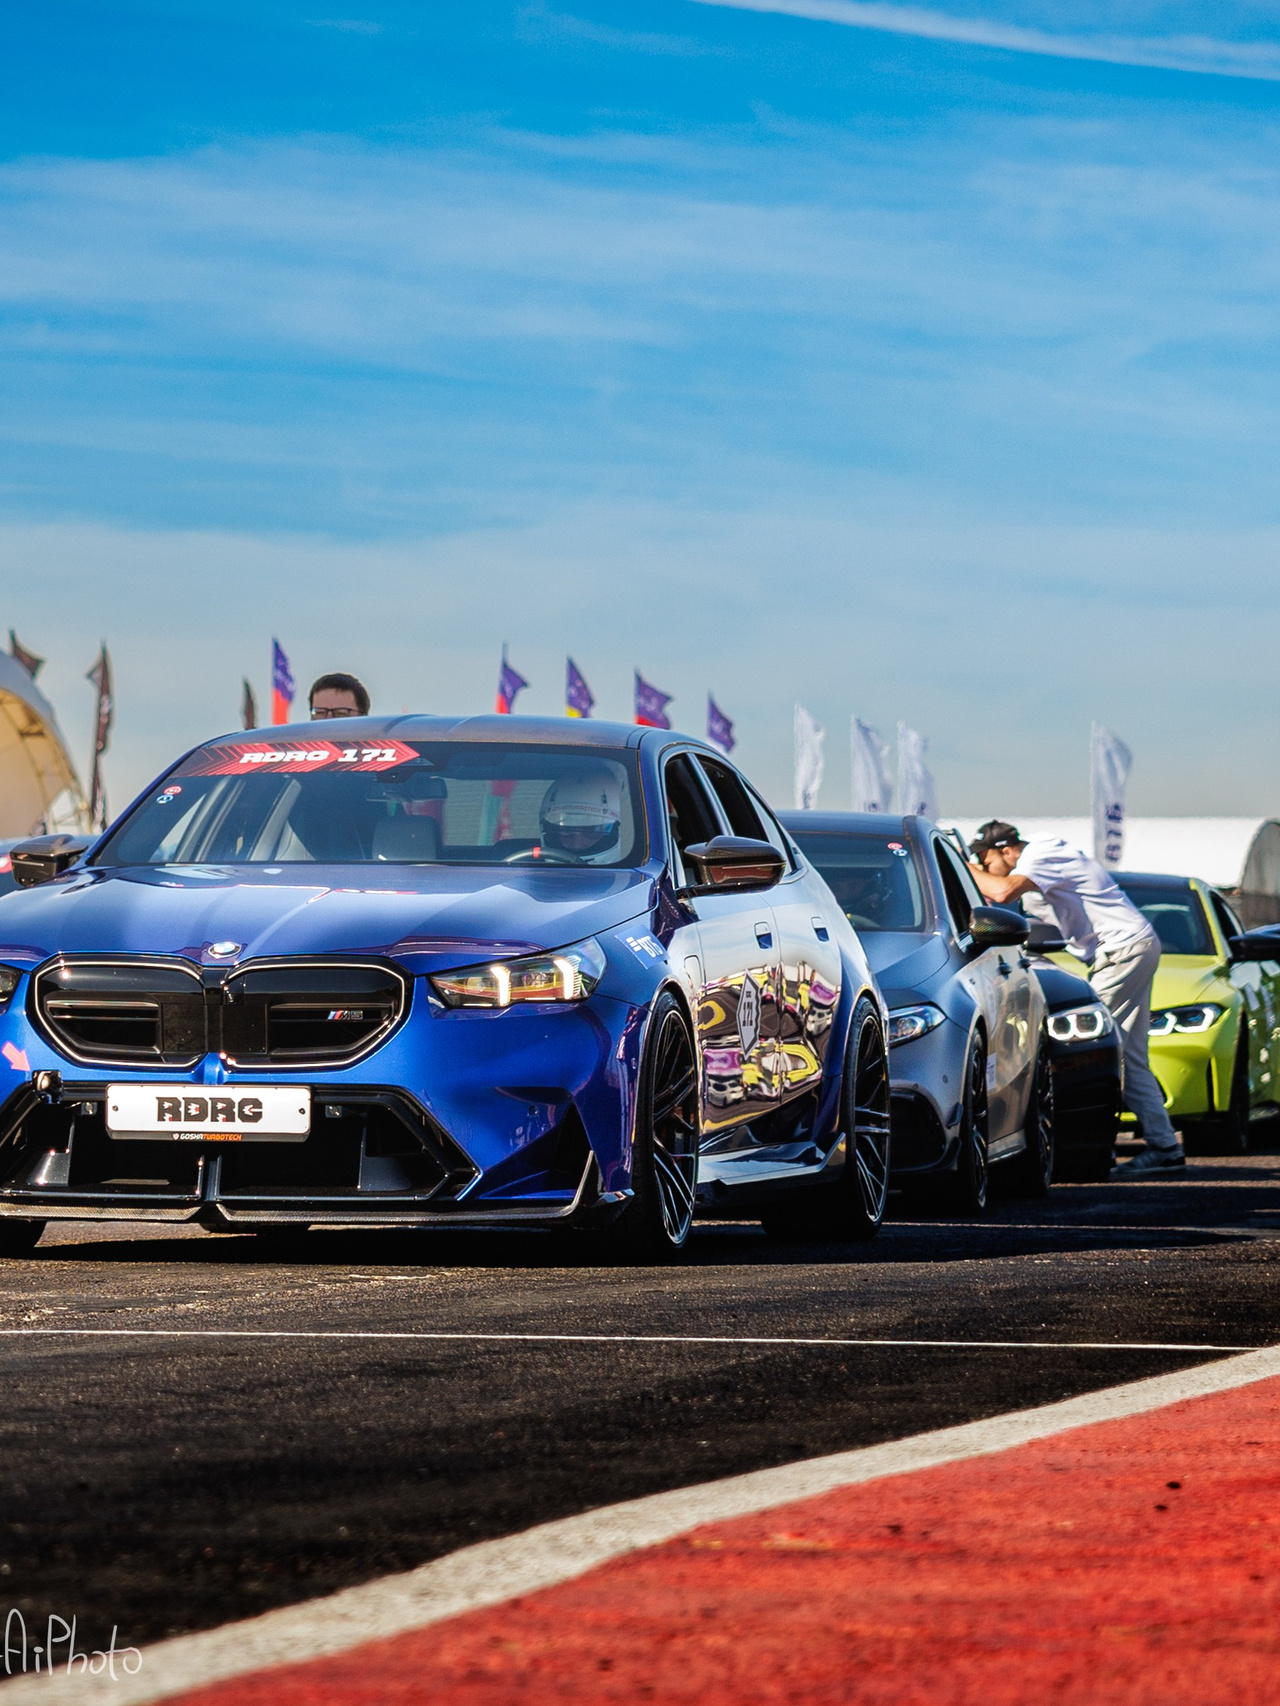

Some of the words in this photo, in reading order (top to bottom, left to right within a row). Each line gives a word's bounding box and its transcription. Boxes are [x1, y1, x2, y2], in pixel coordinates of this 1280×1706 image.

[238, 749, 330, 764] RDRC
[337, 748, 397, 763] 171
[155, 1096, 263, 1123] RDRC
